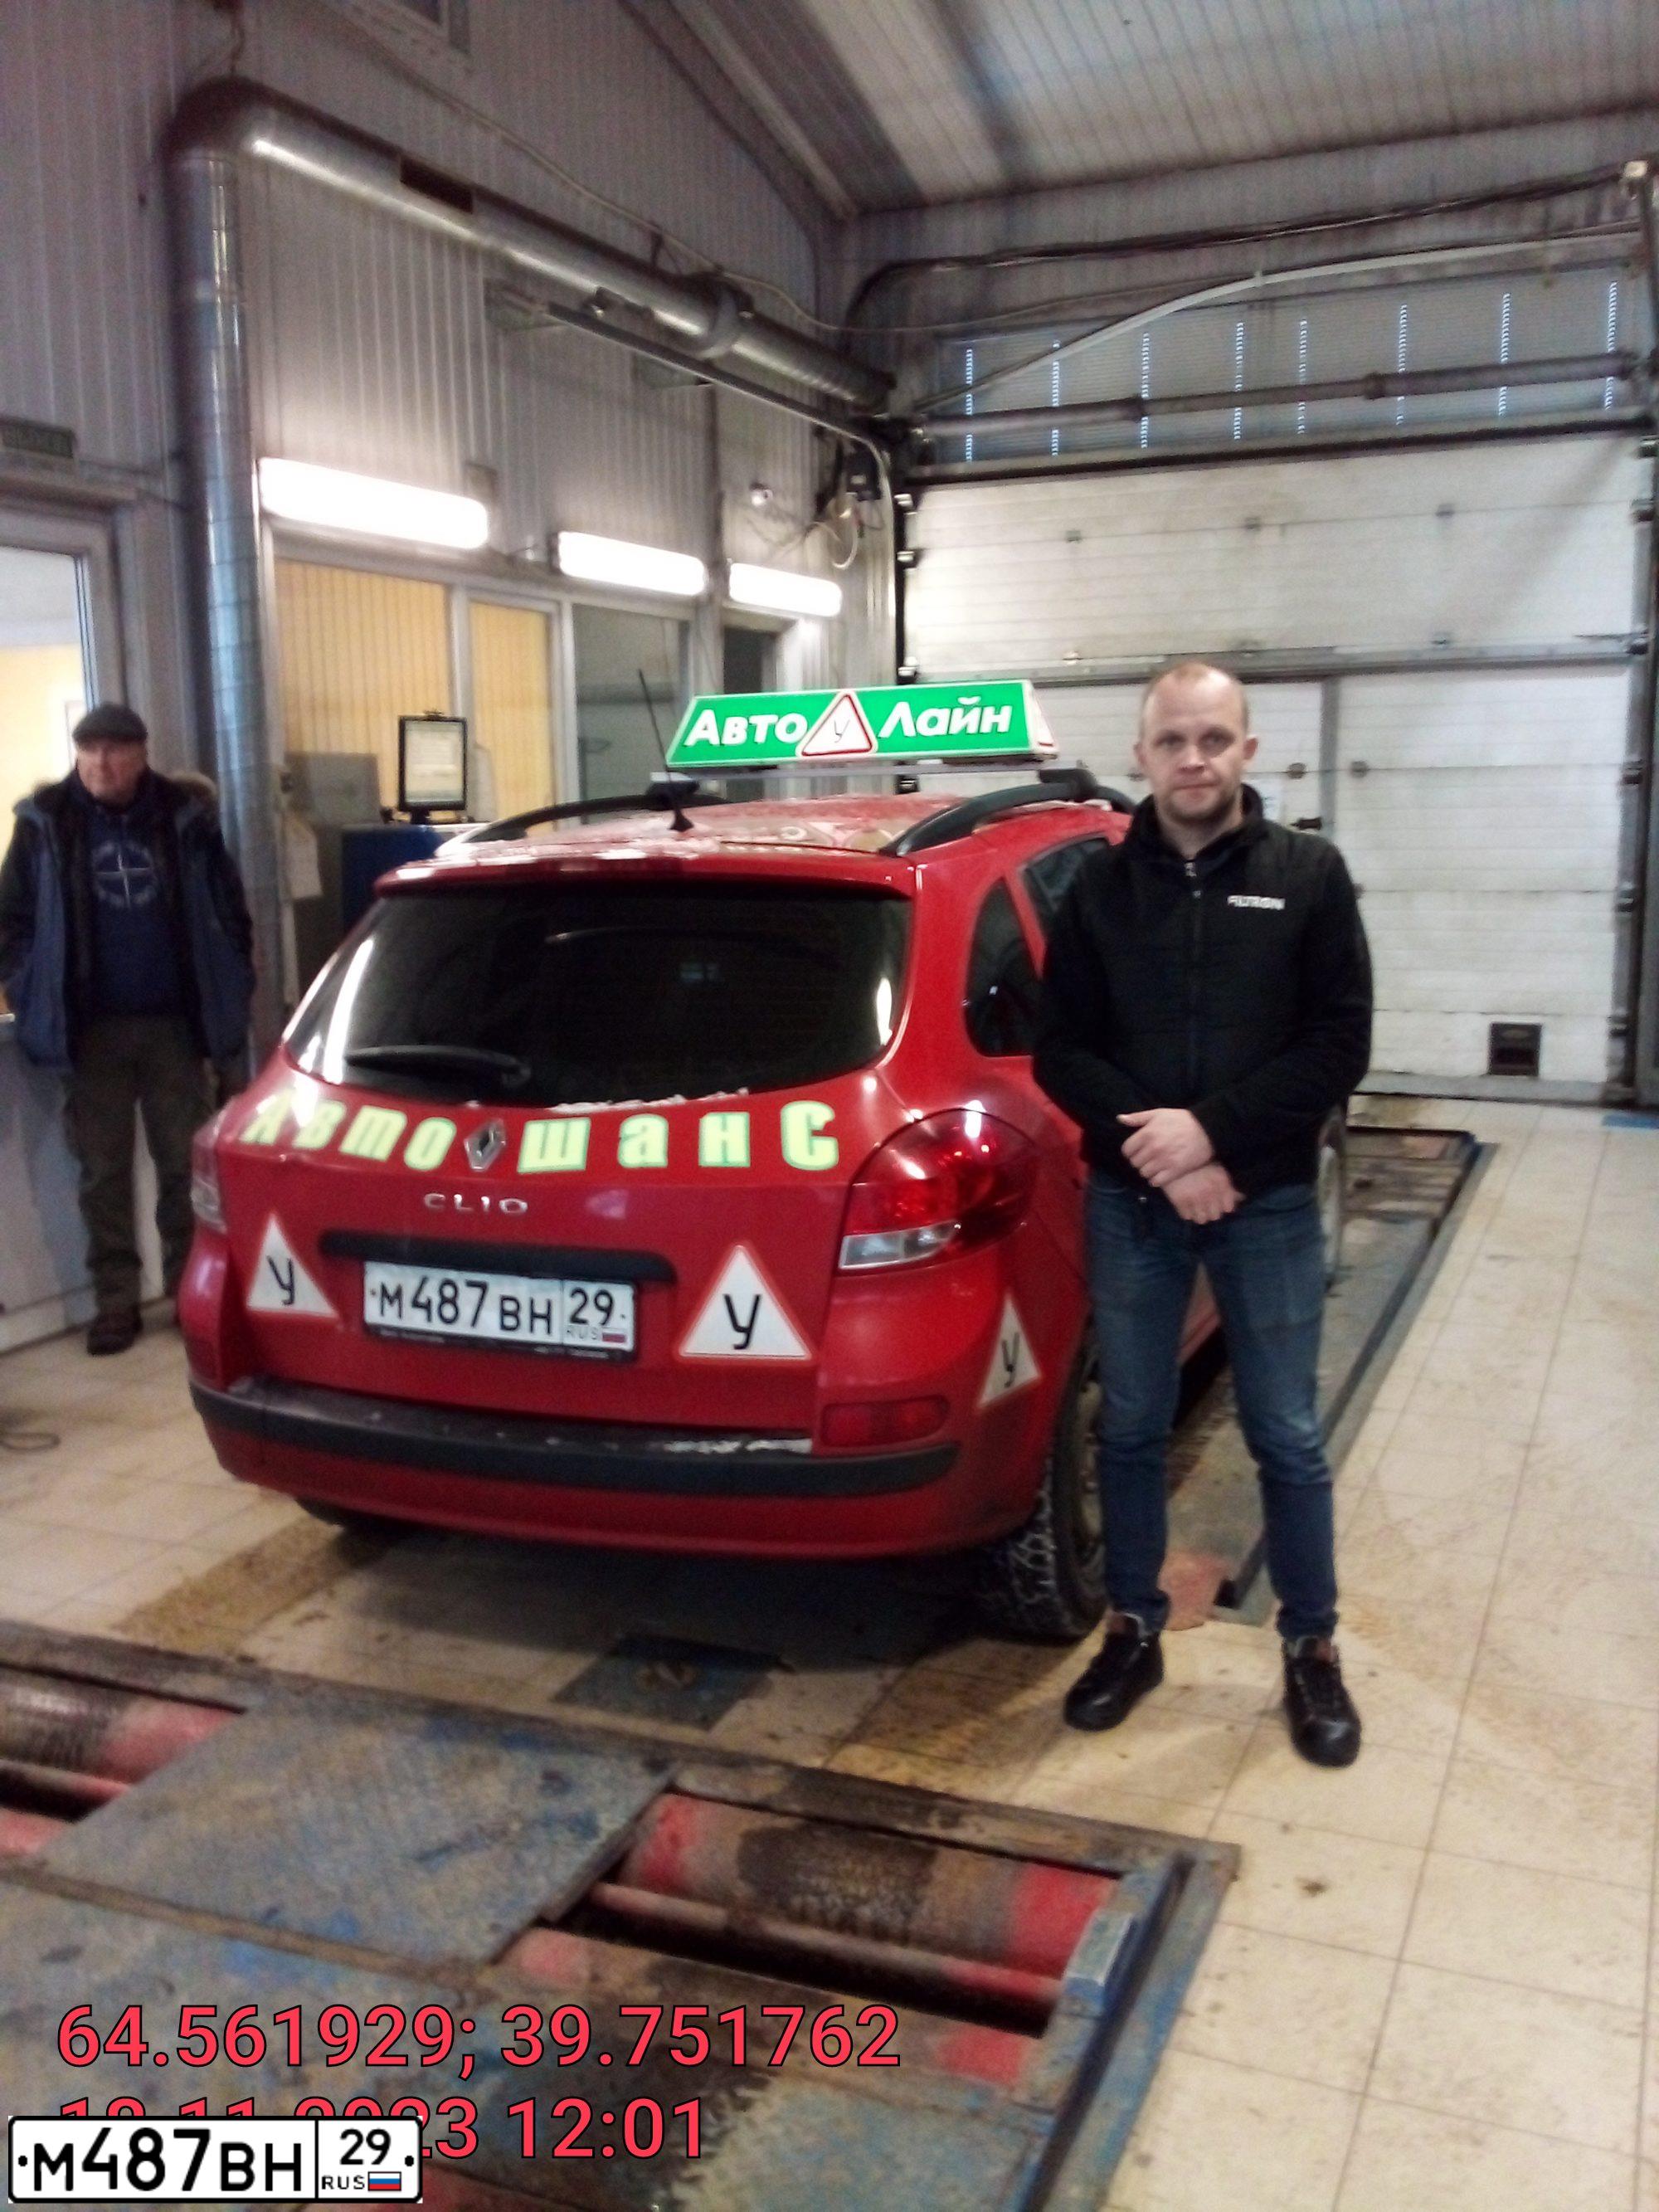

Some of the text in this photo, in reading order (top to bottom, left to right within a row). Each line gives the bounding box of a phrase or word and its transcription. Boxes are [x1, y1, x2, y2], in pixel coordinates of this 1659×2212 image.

[878, 695, 1013, 738] Лайн
[423, 1192, 528, 1216] CLIO
[568, 1287, 615, 1326] 29
